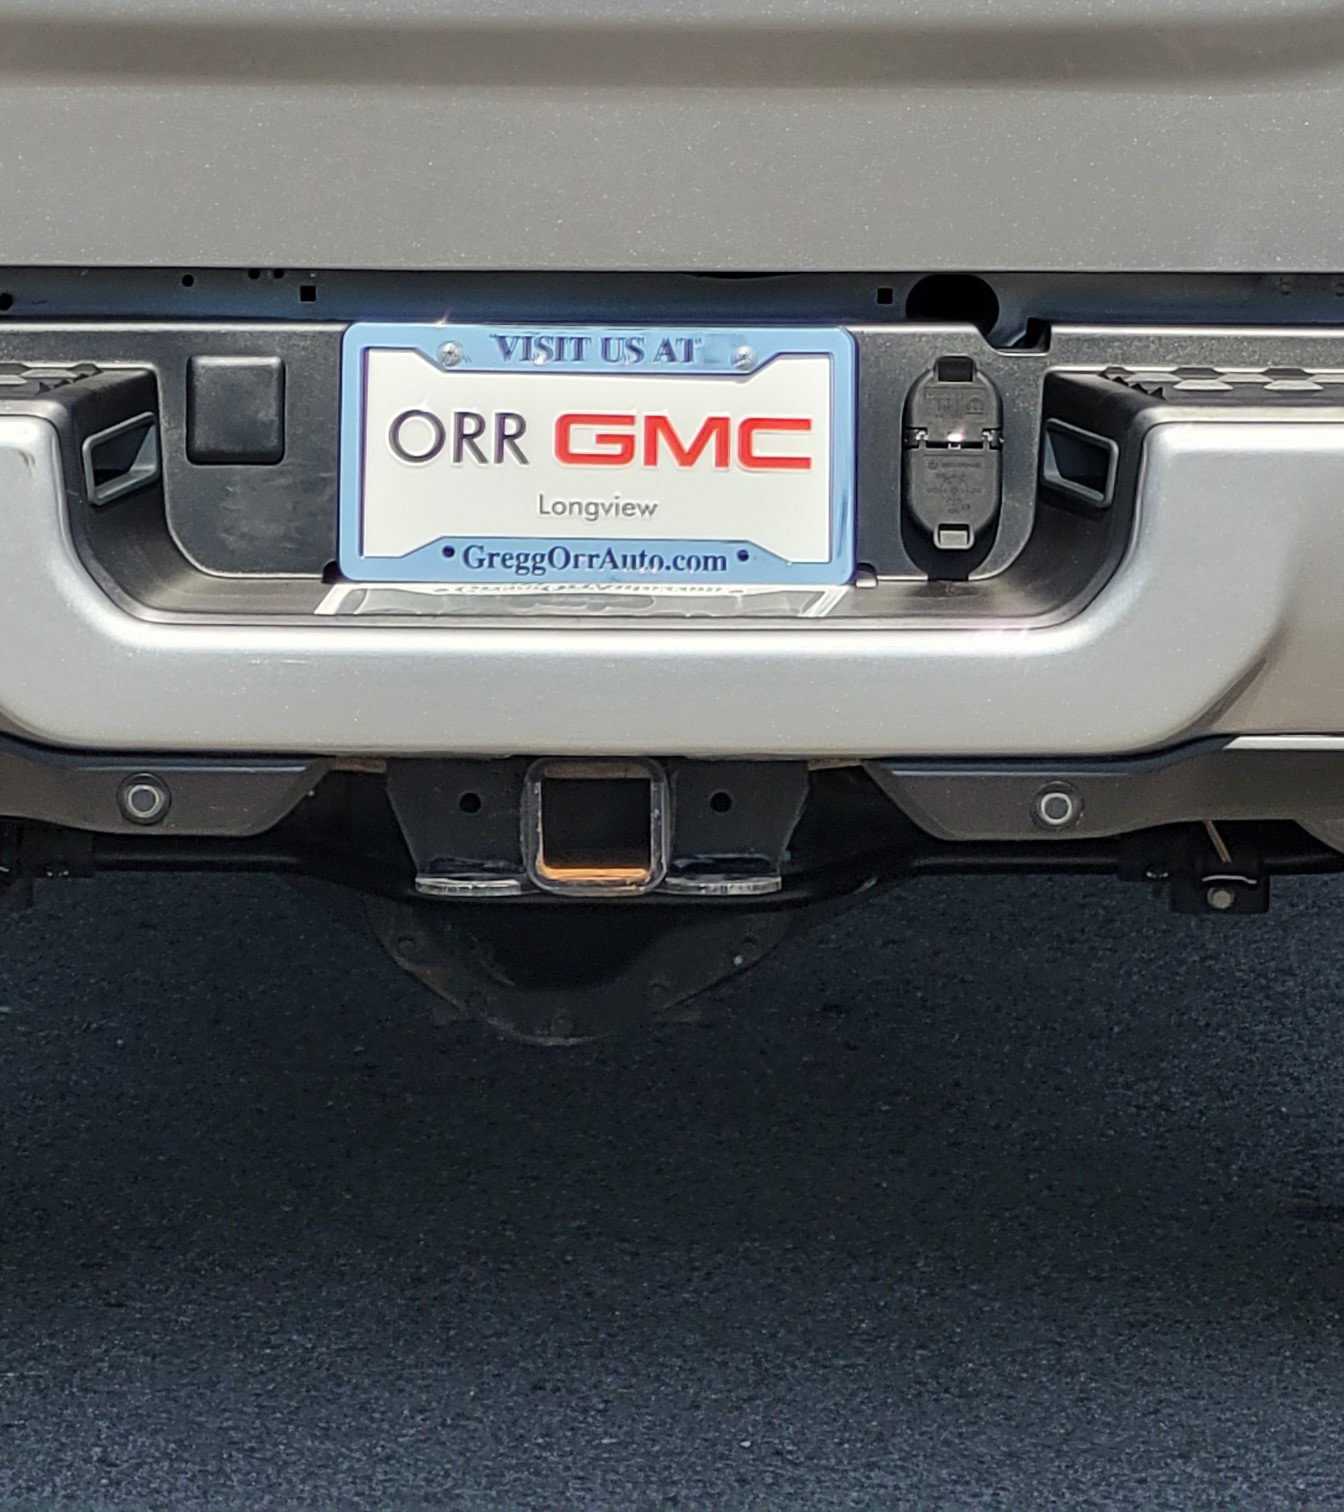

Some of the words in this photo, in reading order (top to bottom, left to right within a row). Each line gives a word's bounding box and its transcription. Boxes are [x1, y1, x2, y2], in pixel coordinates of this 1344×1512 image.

[494, 334, 589, 364] VISIT
[601, 336, 645, 364] US
[653, 337, 699, 365] AT
[388, 409, 527, 465] ORR
[554, 413, 812, 470] GMC
[538, 493, 658, 522] Longview
[462, 544, 727, 576] GreggOrrAuto.com
